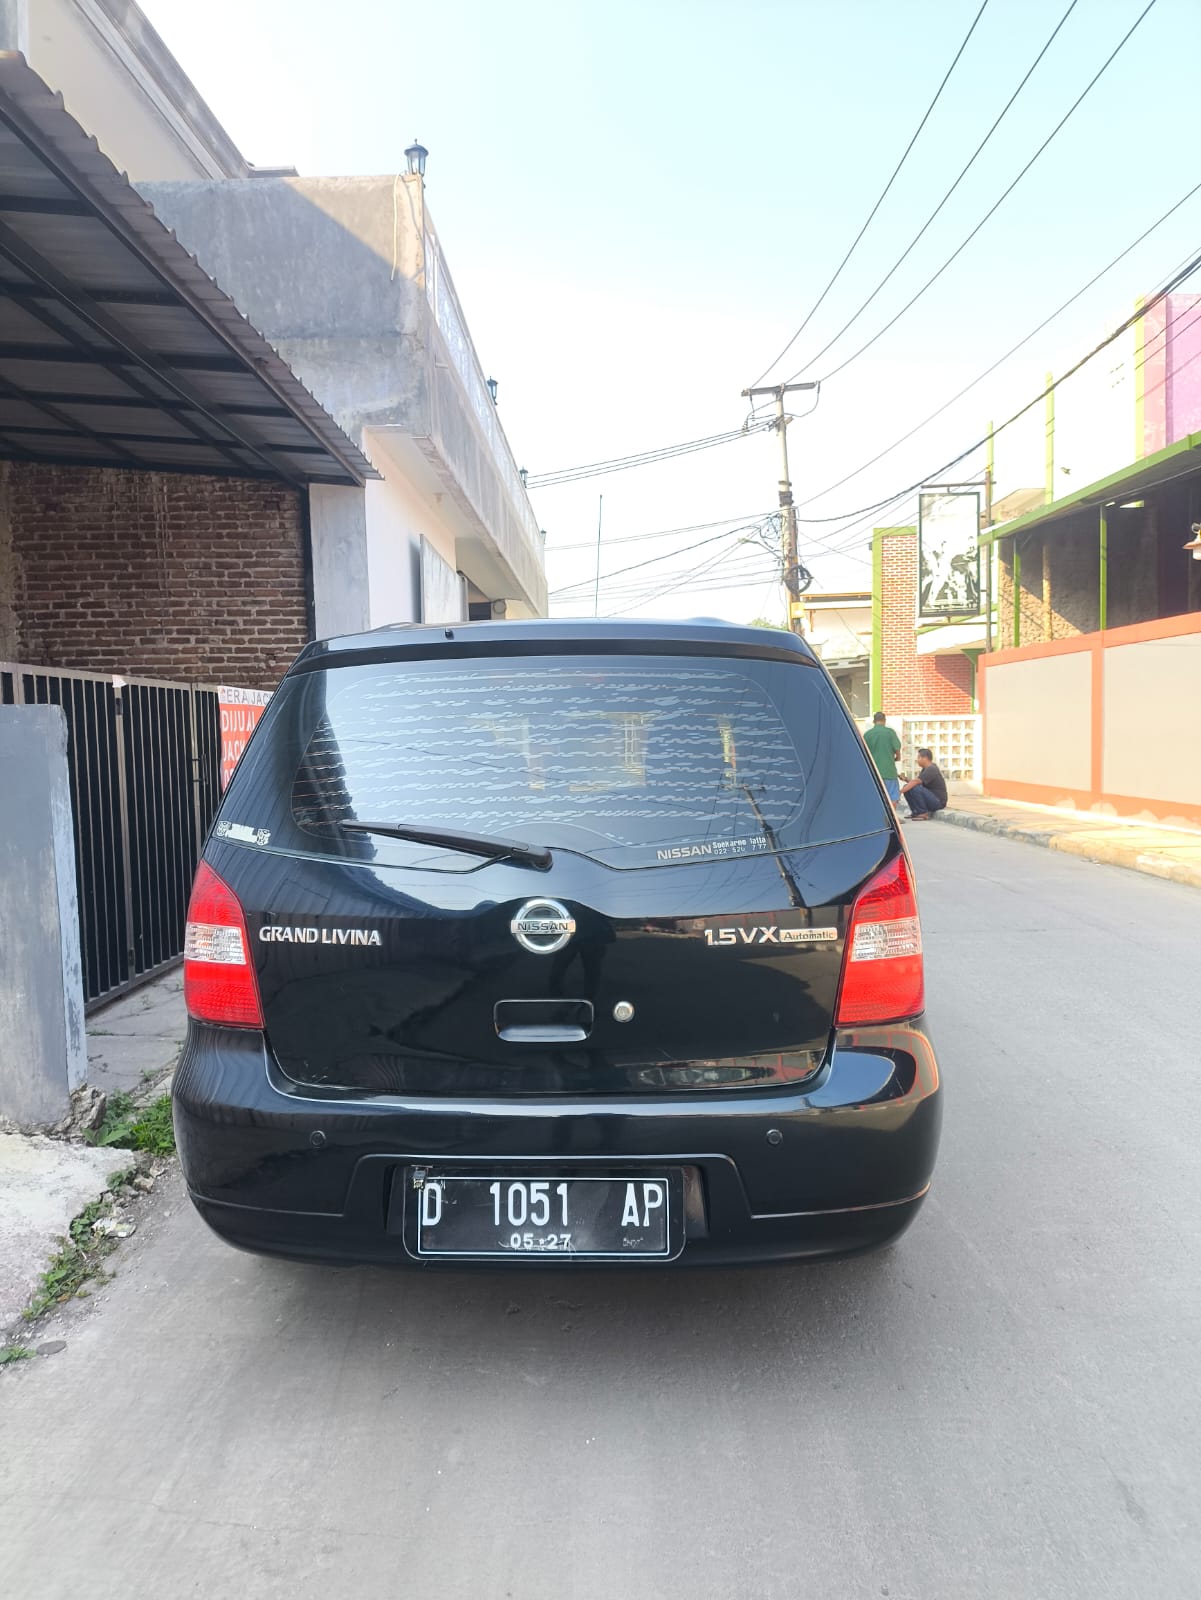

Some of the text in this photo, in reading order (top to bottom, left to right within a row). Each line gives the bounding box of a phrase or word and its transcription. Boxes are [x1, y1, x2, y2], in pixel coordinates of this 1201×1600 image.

[656, 844, 712, 860] NISSAN
[517, 922, 569, 931] NISSAN
[259, 926, 382, 946] GRAND LIVINA
[783, 930, 835, 942] Automatic
[422, 1182, 663, 1228] D 1051 AP
